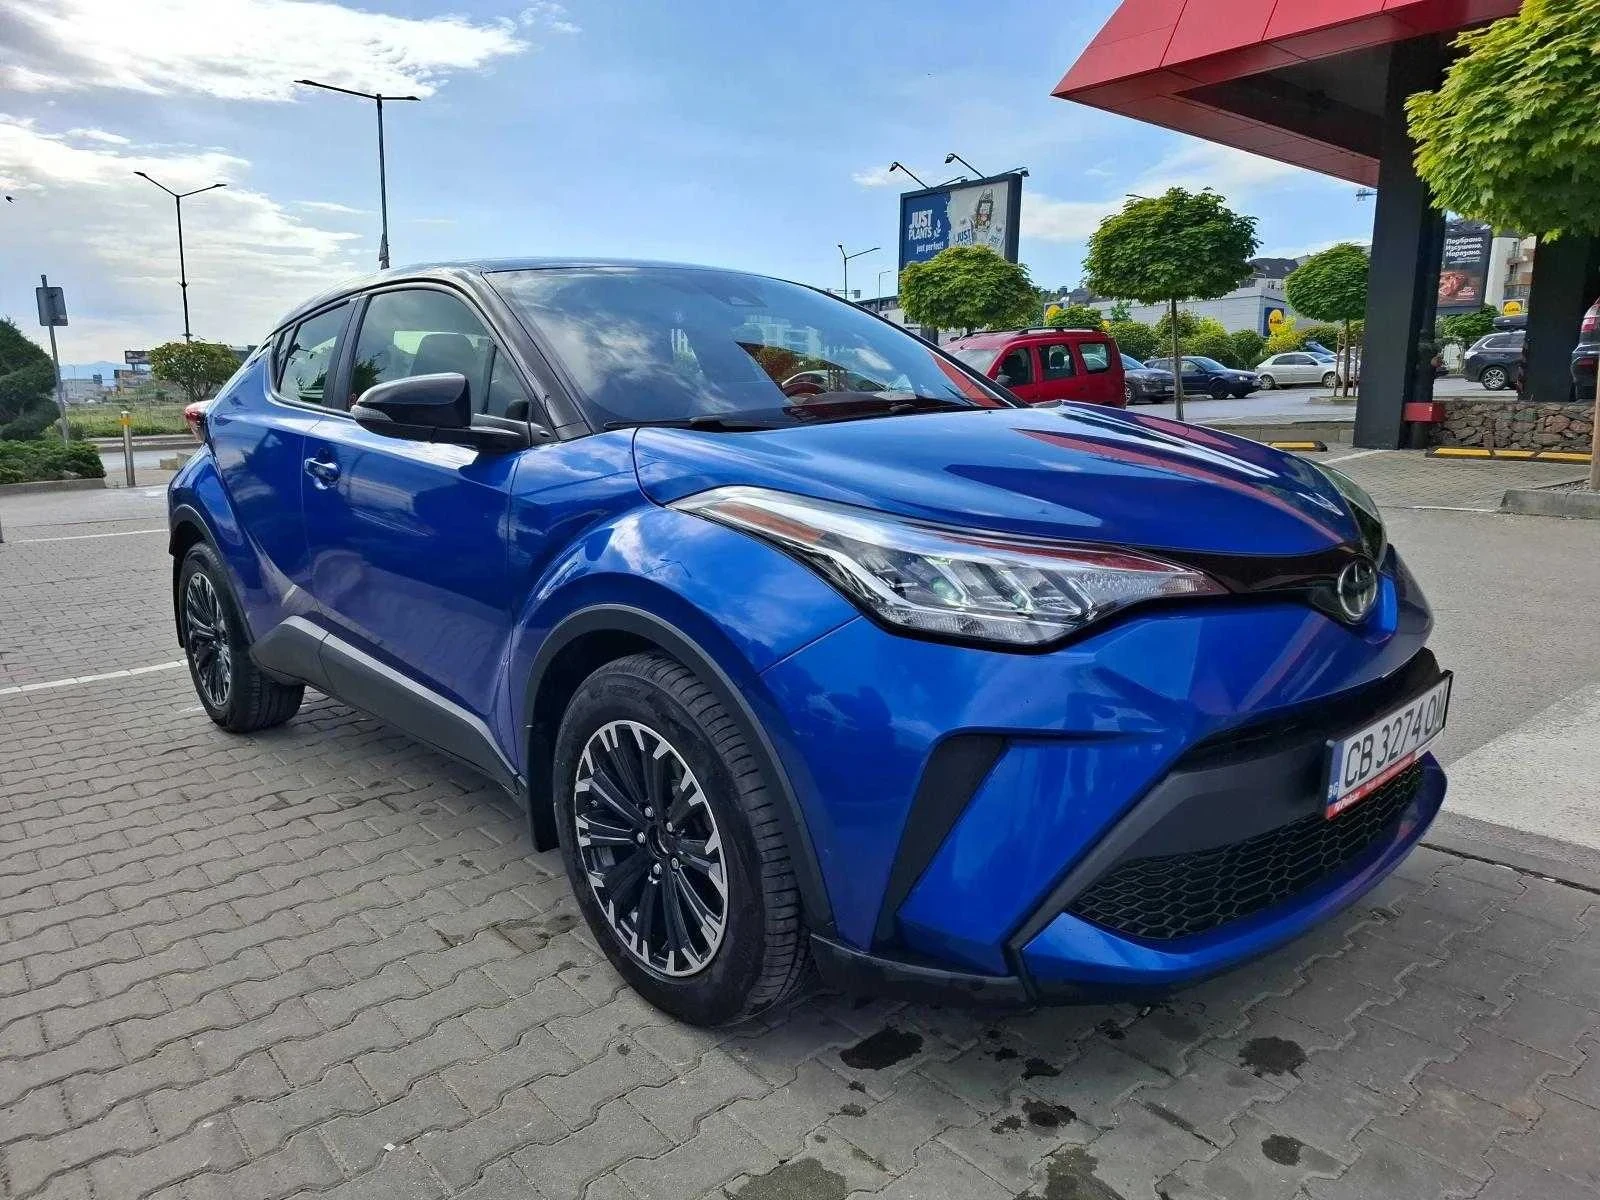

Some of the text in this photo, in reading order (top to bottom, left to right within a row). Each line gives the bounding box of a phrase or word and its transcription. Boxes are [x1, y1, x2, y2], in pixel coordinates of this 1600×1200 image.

[909, 210, 933, 229] JUST
[909, 227, 933, 241] PLANTS
[1344, 733, 1374, 787] CB
[1376, 701, 1424, 769] 3274
